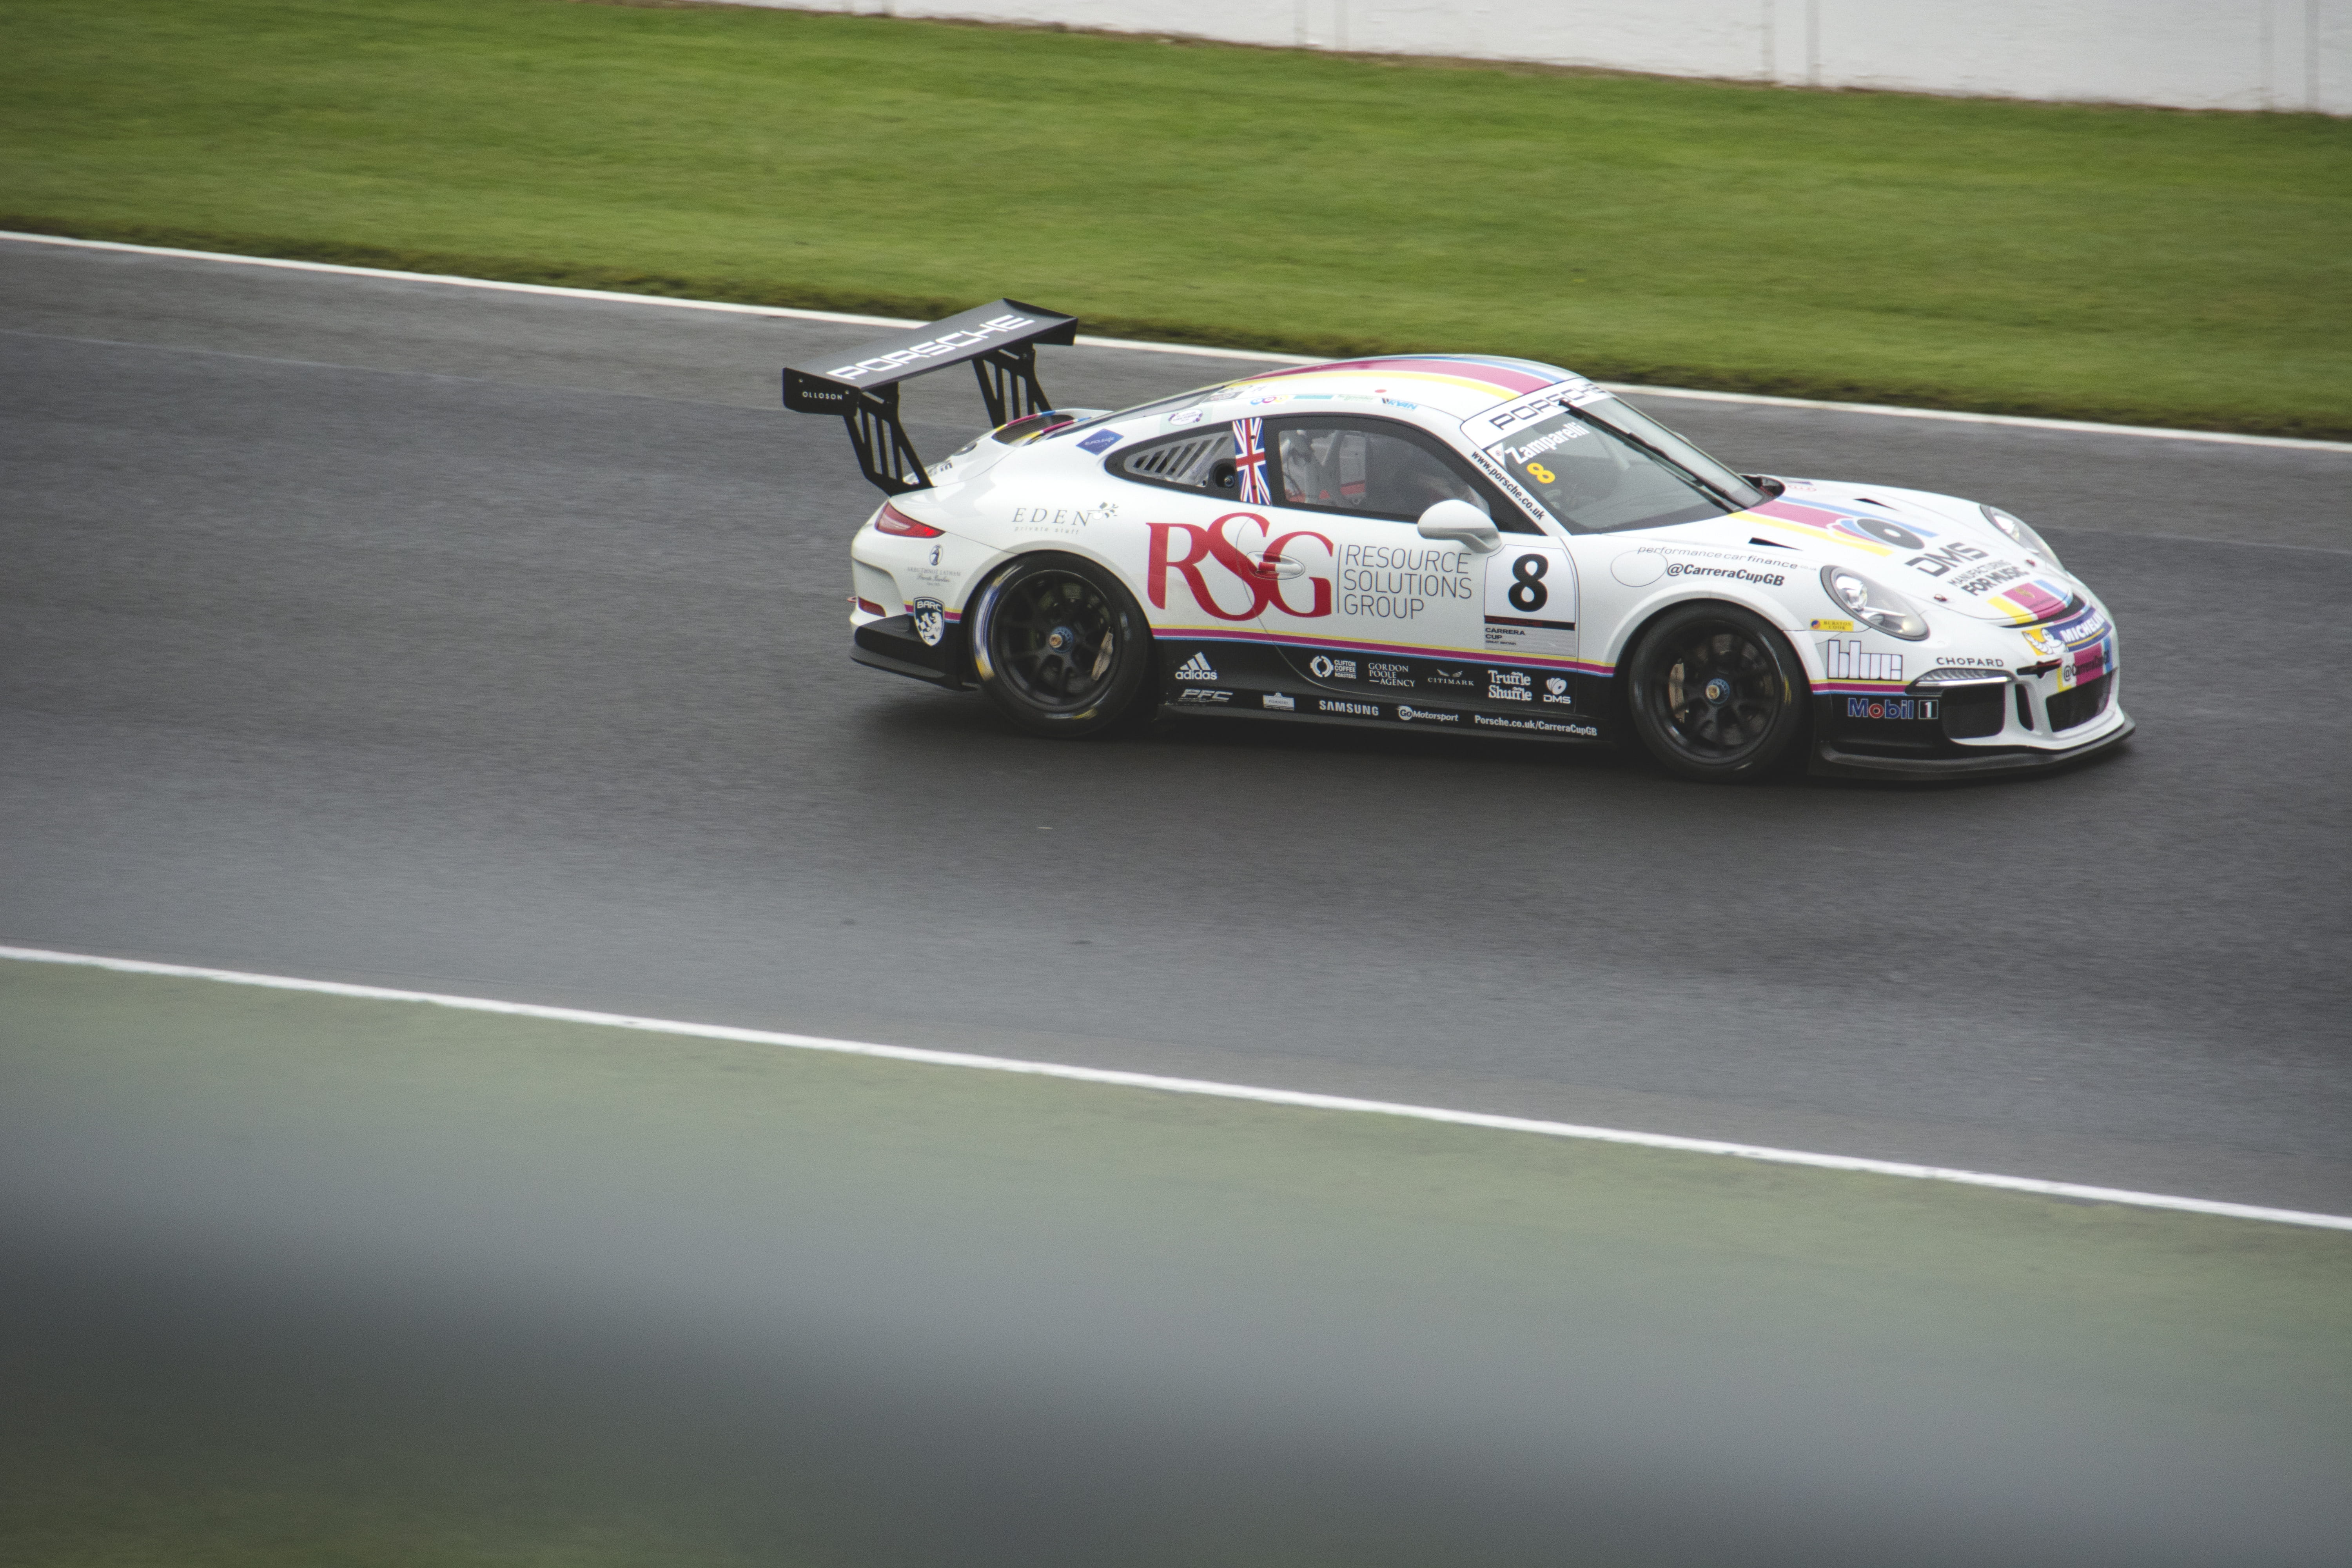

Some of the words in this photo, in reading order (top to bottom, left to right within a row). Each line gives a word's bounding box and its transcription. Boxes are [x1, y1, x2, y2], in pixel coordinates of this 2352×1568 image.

[826, 314, 1035, 379] PORSCHE
[802, 391, 842, 400] OLLOSON
[1489, 383, 1606, 430] PORSCHE
[1505, 421, 1590, 465] Zamparelli
[1526, 462, 1555, 484] 8
[1472, 451, 1545, 520] www.porsche.co.uk
[1012, 508, 1093, 526] EDEN
[1146, 512, 1334, 621] RSG
[1346, 544, 1473, 574] RESOURCE
[1636, 545, 1722, 558] performance
[1747, 555, 1798, 570] finance
[1904, 542, 1989, 577] DMS
[1344, 569, 1473, 599] SOLUTIONS
[1508, 553, 1549, 612] 8
[1666, 563, 1786, 587] @CarreraCupGB
[1960, 578, 1998, 596] FOR
[917, 601, 942, 612] BARC
[1344, 594, 1425, 619] GROUP
[1485, 628, 1526, 636] CARRERA
[2059, 610, 2106, 643] MICHELIN
[1368, 663, 1409, 672] GORDON
[1936, 657, 2004, 667] CHOPARD
[1176, 670, 1217, 680] adidas
[1369, 670, 1396, 679] POOLE
[1379, 678, 1415, 687] AGENCY
[1428, 677, 1475, 686] CITIMARK
[1488, 670, 1531, 686] Truffle
[1181, 689, 1234, 700] PFC
[1488, 684, 1533, 701] Shuffle
[1543, 694, 1572, 704] DMS
[1319, 701, 1379, 716] SAMSUNG
[1847, 697, 1915, 720] Mobil
[1474, 715, 1598, 737] Porsche.co.uk/CarreraCupGB
